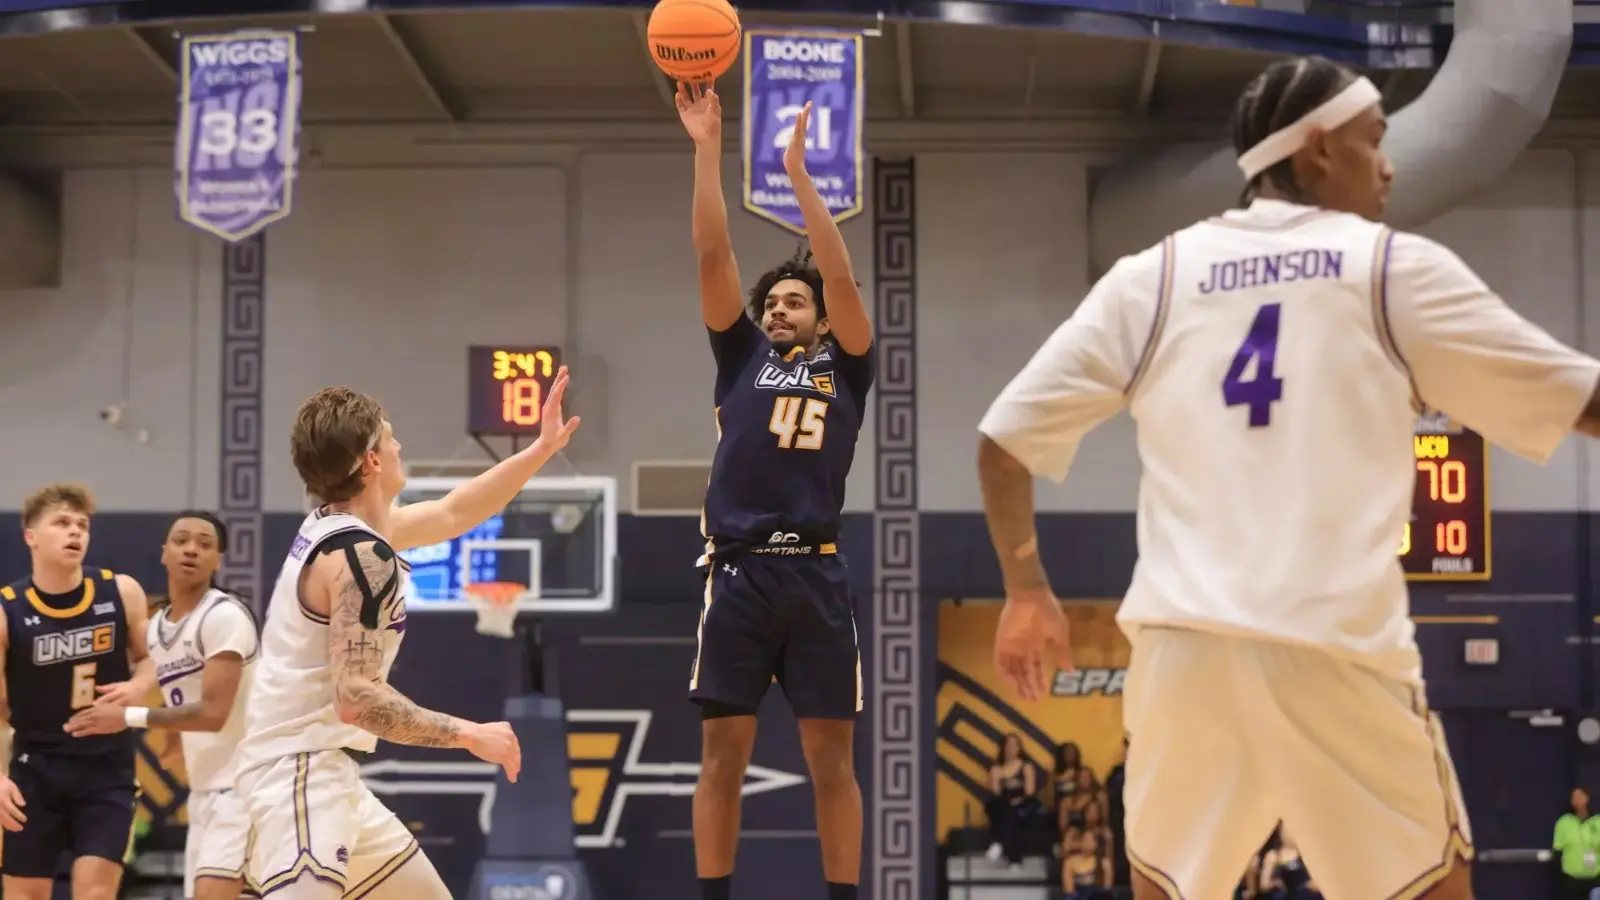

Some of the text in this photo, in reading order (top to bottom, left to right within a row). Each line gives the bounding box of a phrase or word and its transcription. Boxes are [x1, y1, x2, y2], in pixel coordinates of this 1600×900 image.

[191, 40, 287, 66] WIGGS
[656, 44, 716, 61] Wilson
[763, 39, 845, 63] BOONE
[200, 109, 278, 155] 33
[773, 104, 831, 150] 21
[1198, 249, 1343, 294] JOHNSON
[493, 350, 553, 380] 3:47
[1221, 302, 1283, 428] 4
[503, 378, 541, 425] 18
[769, 396, 829, 450] 45
[1414, 435, 1449, 458] WCU
[1416, 461, 1466, 503] 70
[1436, 520, 1467, 555] 10
[1432, 558, 1473, 573] FOULS
[34, 623, 116, 665] UNCG
[71, 662, 97, 710] 6
[170, 687, 183, 706] 0
[1052, 668, 1128, 697] SPA
